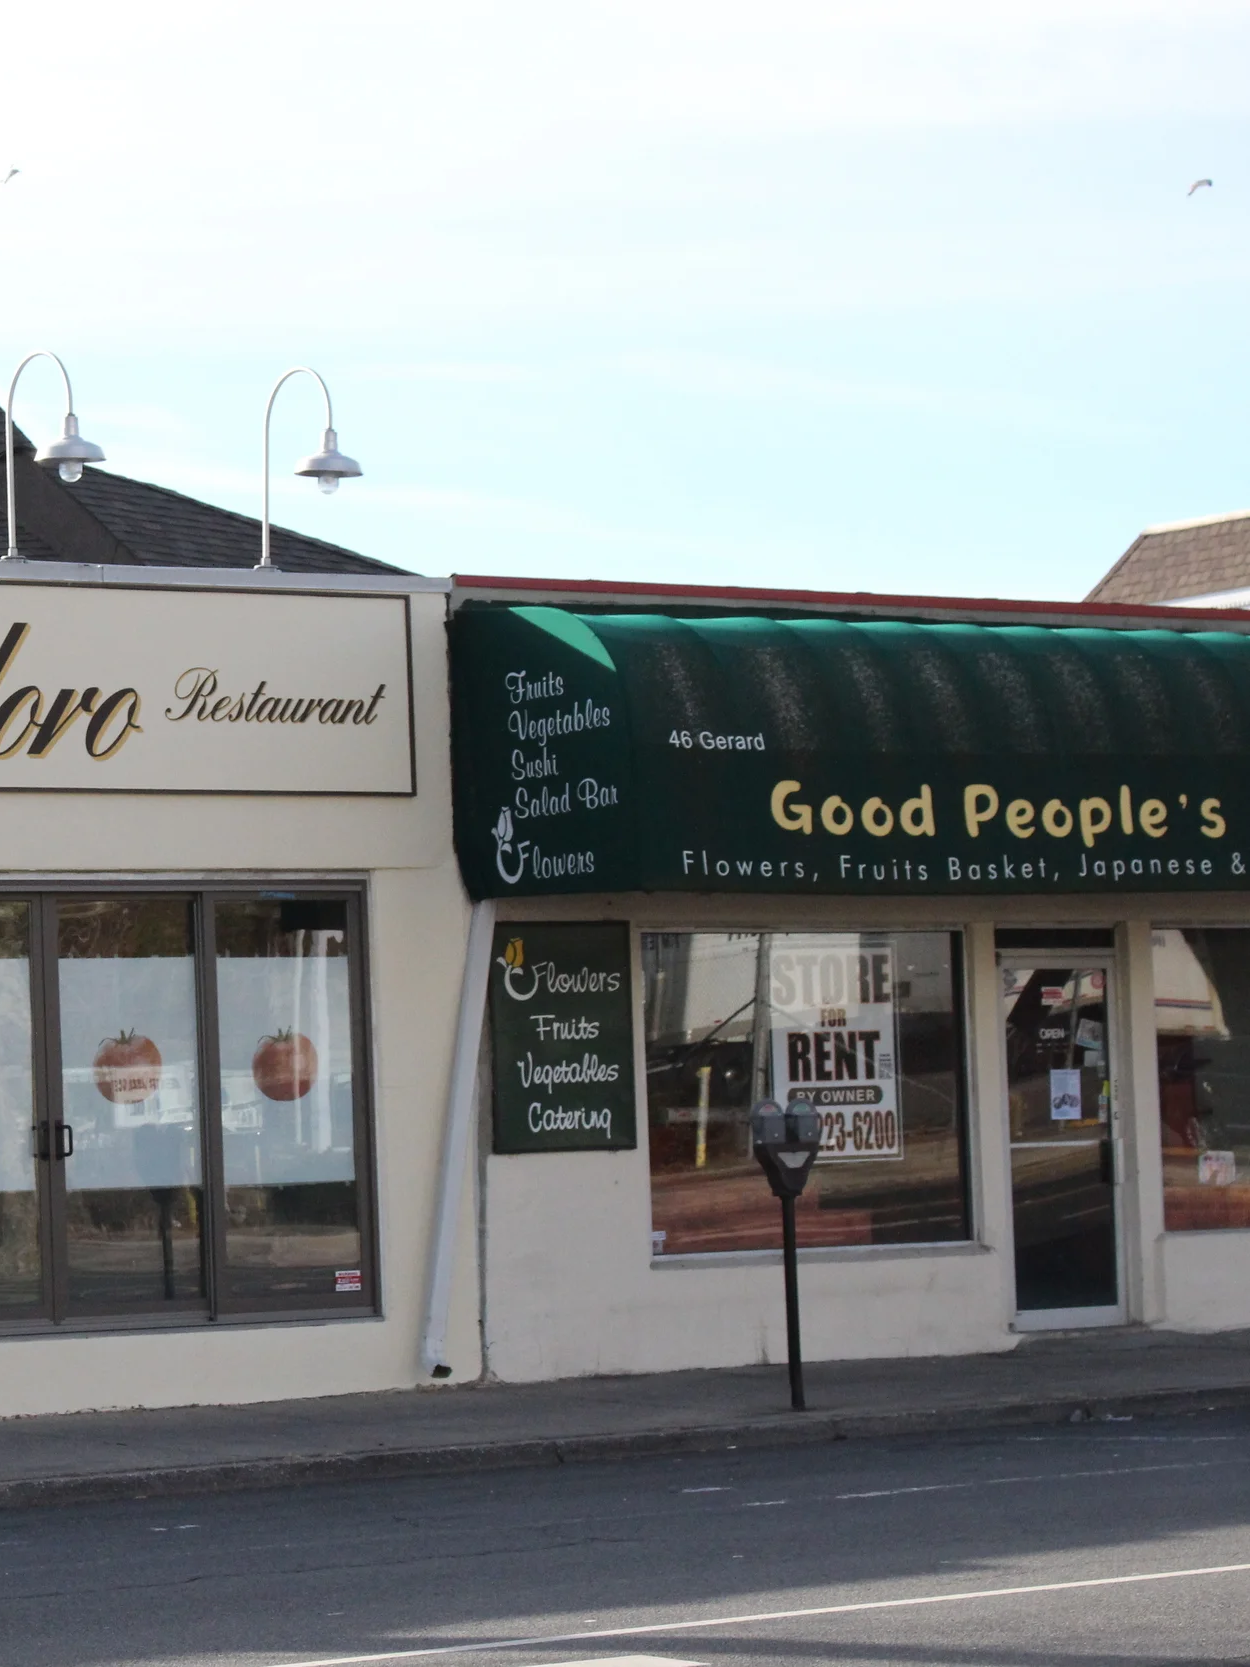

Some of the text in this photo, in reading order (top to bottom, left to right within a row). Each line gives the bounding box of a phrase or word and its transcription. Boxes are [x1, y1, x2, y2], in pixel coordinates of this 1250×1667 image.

[165, 667, 387, 726] Restaurant
[505, 670, 564, 704] Fruits
[508, 699, 611, 746] Vegetables
[668, 729, 766, 752] 46 Gerard
[512, 747, 559, 780] Sushi
[514, 777, 619, 818] Salad Bar
[770, 779, 1227, 848] Good People's
[496, 840, 595, 884] Flowers
[682, 850, 1248, 882] Flowers, Fruits Basket, Japanese &
[504, 961, 621, 1001] Flowers
[772, 954, 891, 1006] STORE
[530, 1014, 600, 1041] Fruits
[819, 1007, 847, 1028] FOR
[517, 1052, 620, 1095] Vegetables
[787, 1029, 880, 1083] RENT
[820, 1089, 876, 1103] OWNER
[528, 1102, 613, 1139] Catering
